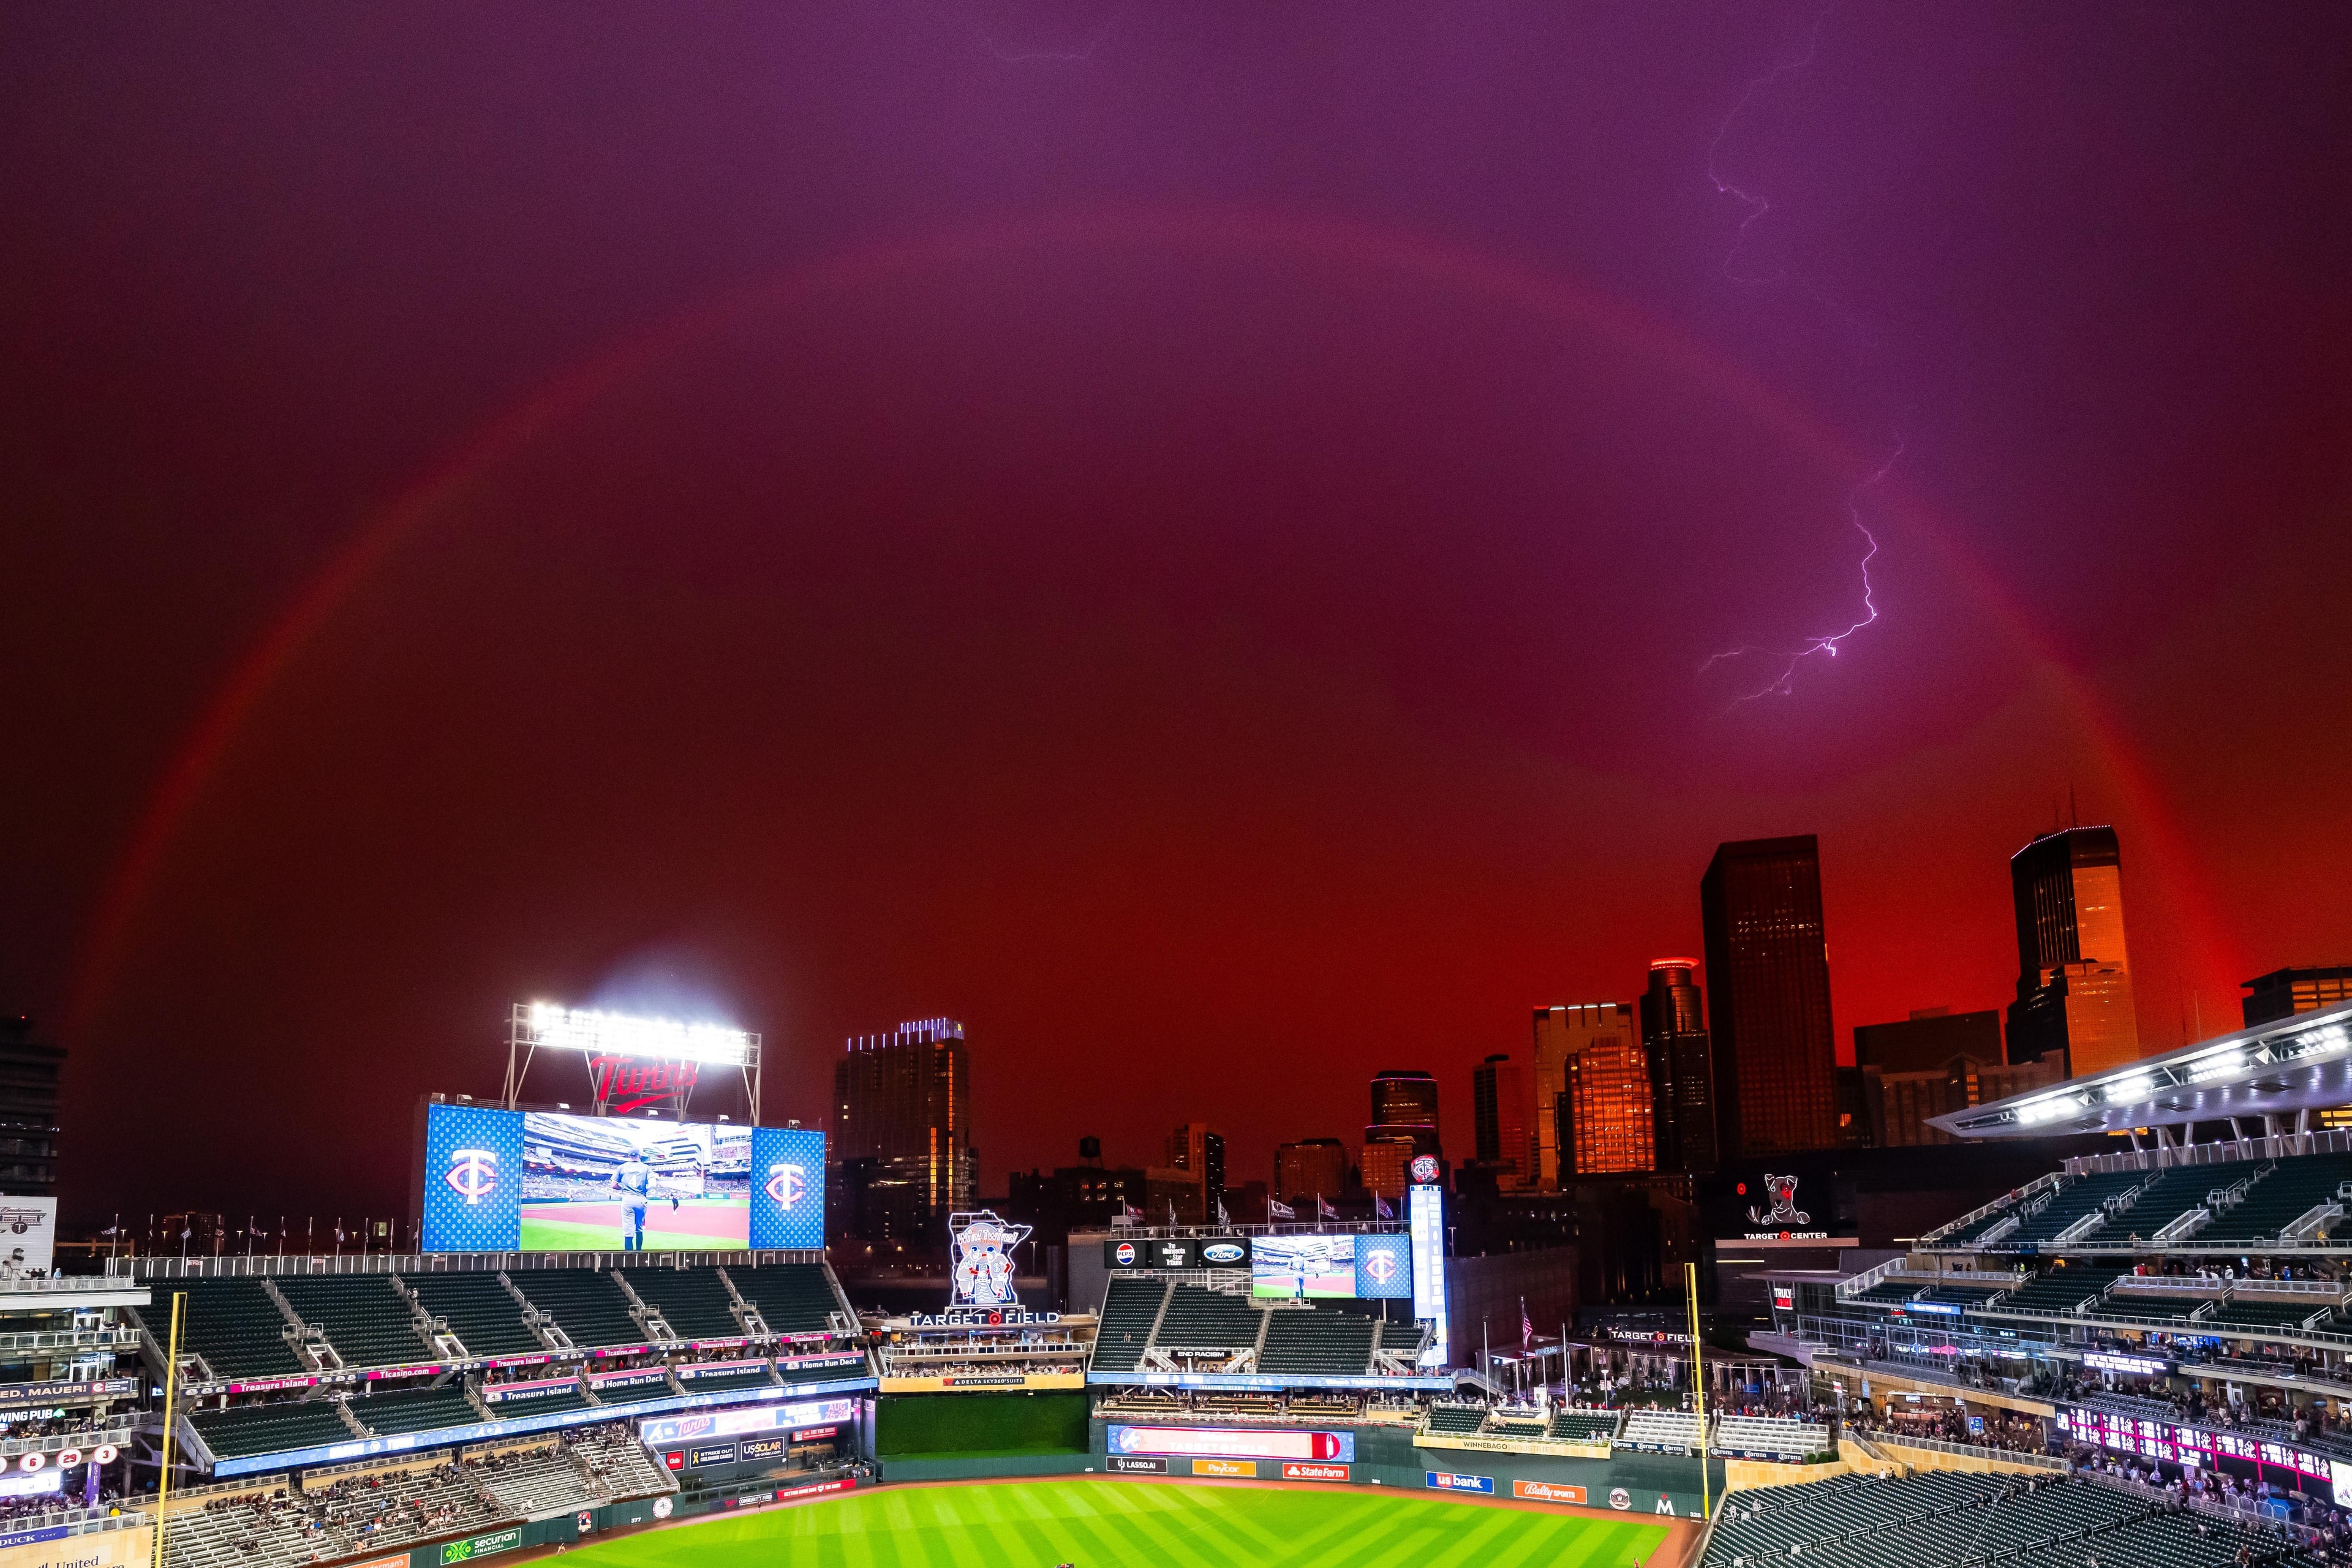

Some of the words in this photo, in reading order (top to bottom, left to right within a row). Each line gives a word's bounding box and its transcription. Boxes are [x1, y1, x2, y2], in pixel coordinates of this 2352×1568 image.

[590, 1055, 697, 1112] Twins
[1211, 1248, 1236, 1259] Ford
[993, 1262, 1001, 1273] S
[1774, 1288, 1792, 1298] TRULY
[911, 1314, 986, 1325] TARGET
[1006, 1313, 1060, 1324] FIELD
[1611, 1331, 1654, 1341] TARGET
[737, 1366, 760, 1374] Island
[240, 1382, 280, 1392] Treasure
[282, 1378, 309, 1388] Island
[606, 1379, 629, 1389] Home
[646, 1374, 663, 1383] Deck
[28, 1385, 87, 1396] MAUER!
[507, 1390, 545, 1401] Treasure
[547, 1385, 571, 1395] Island
[827, 1403, 846, 1412] AUG
[29, 1409, 53, 1420] PUB
[824, 1410, 848, 1421] 26-28
[675, 1417, 710, 1437] Twins
[1463, 1441, 1507, 1450] WINNEBAGO
[1507, 1444, 1555, 1453] INDUSTRIES
[1612, 1440, 1632, 1449] Corona
[1637, 1442, 1658, 1450] Corona
[63, 1454, 77, 1463] 29
[1126, 1461, 1156, 1470] LASSO.AI
[1208, 1462, 1240, 1473] Paycor
[1438, 1476, 1451, 1485] us
[1525, 1483, 1553, 1499] Bally
[1553, 1490, 1575, 1499] SPORTS
[739, 1495, 762, 1504] COMMUNITY
[1655, 1499, 1676, 1516] M
[475, 1532, 516, 1548] securian
[475, 1544, 504, 1554] FINANCIAL
[56, 1556, 99, 1568] United
